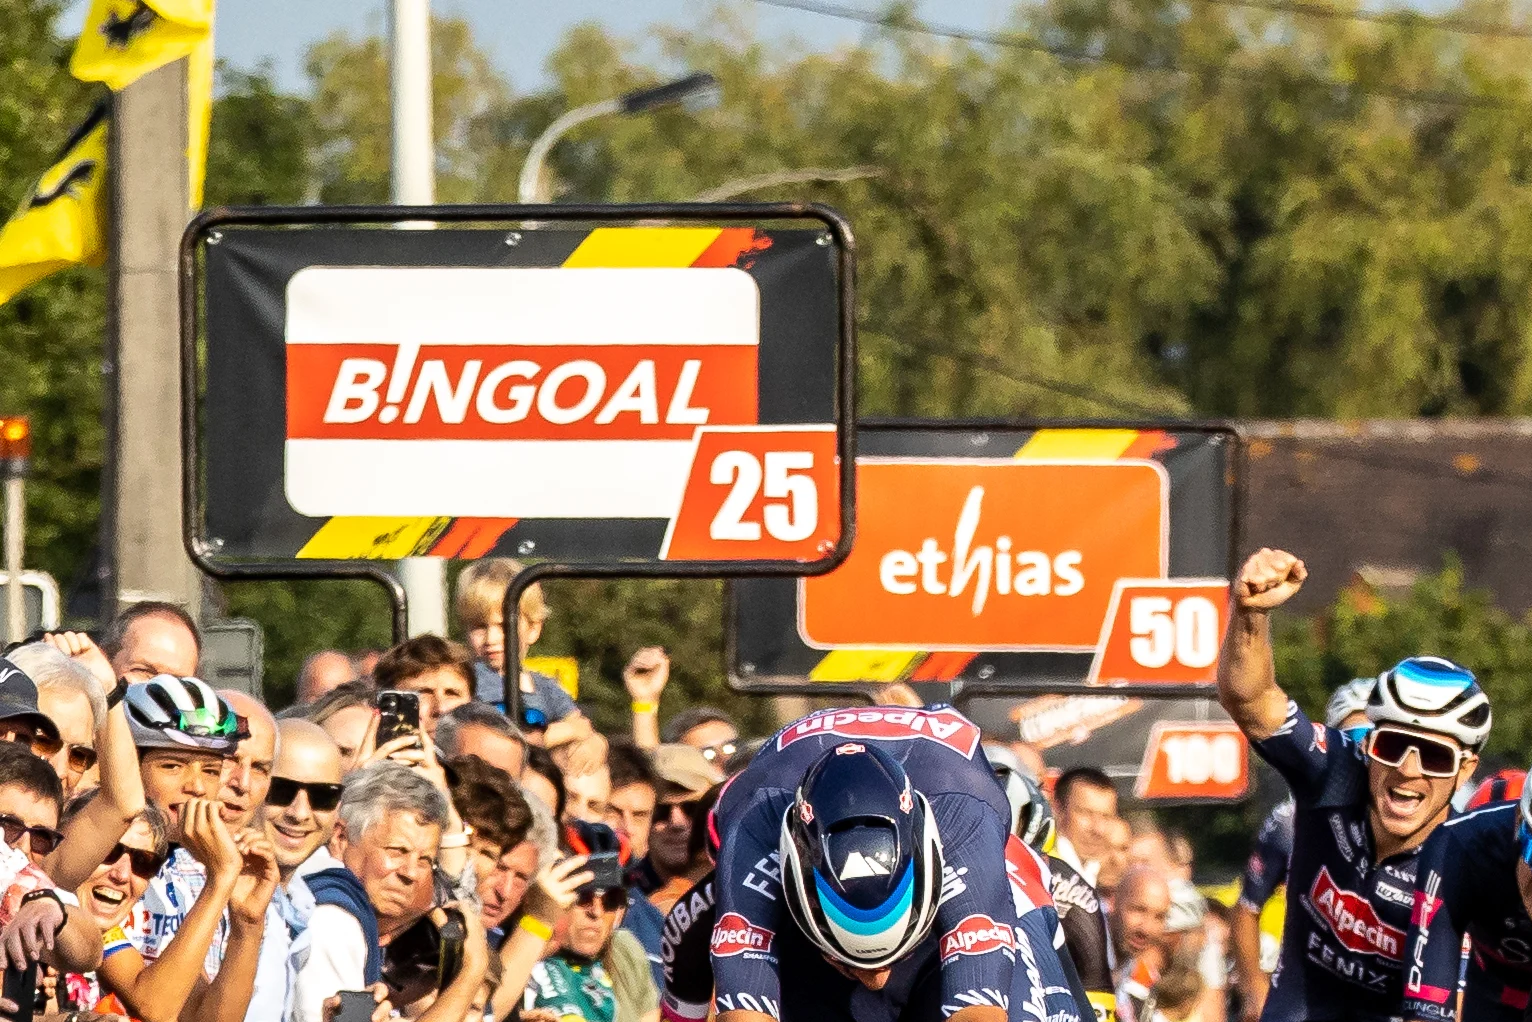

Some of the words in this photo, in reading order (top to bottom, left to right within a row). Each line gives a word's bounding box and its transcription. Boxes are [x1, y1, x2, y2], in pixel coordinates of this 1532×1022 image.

[709, 449, 819, 542] 25
[880, 486, 1085, 616] ethias
[1129, 597, 1220, 668] 50
[796, 709, 965, 740] Alpecin
[1161, 734, 1242, 784] 100
[945, 924, 1012, 953] Alpecin
[1318, 887, 1398, 955] Alpecin
[1307, 931, 1389, 987] FENIX
